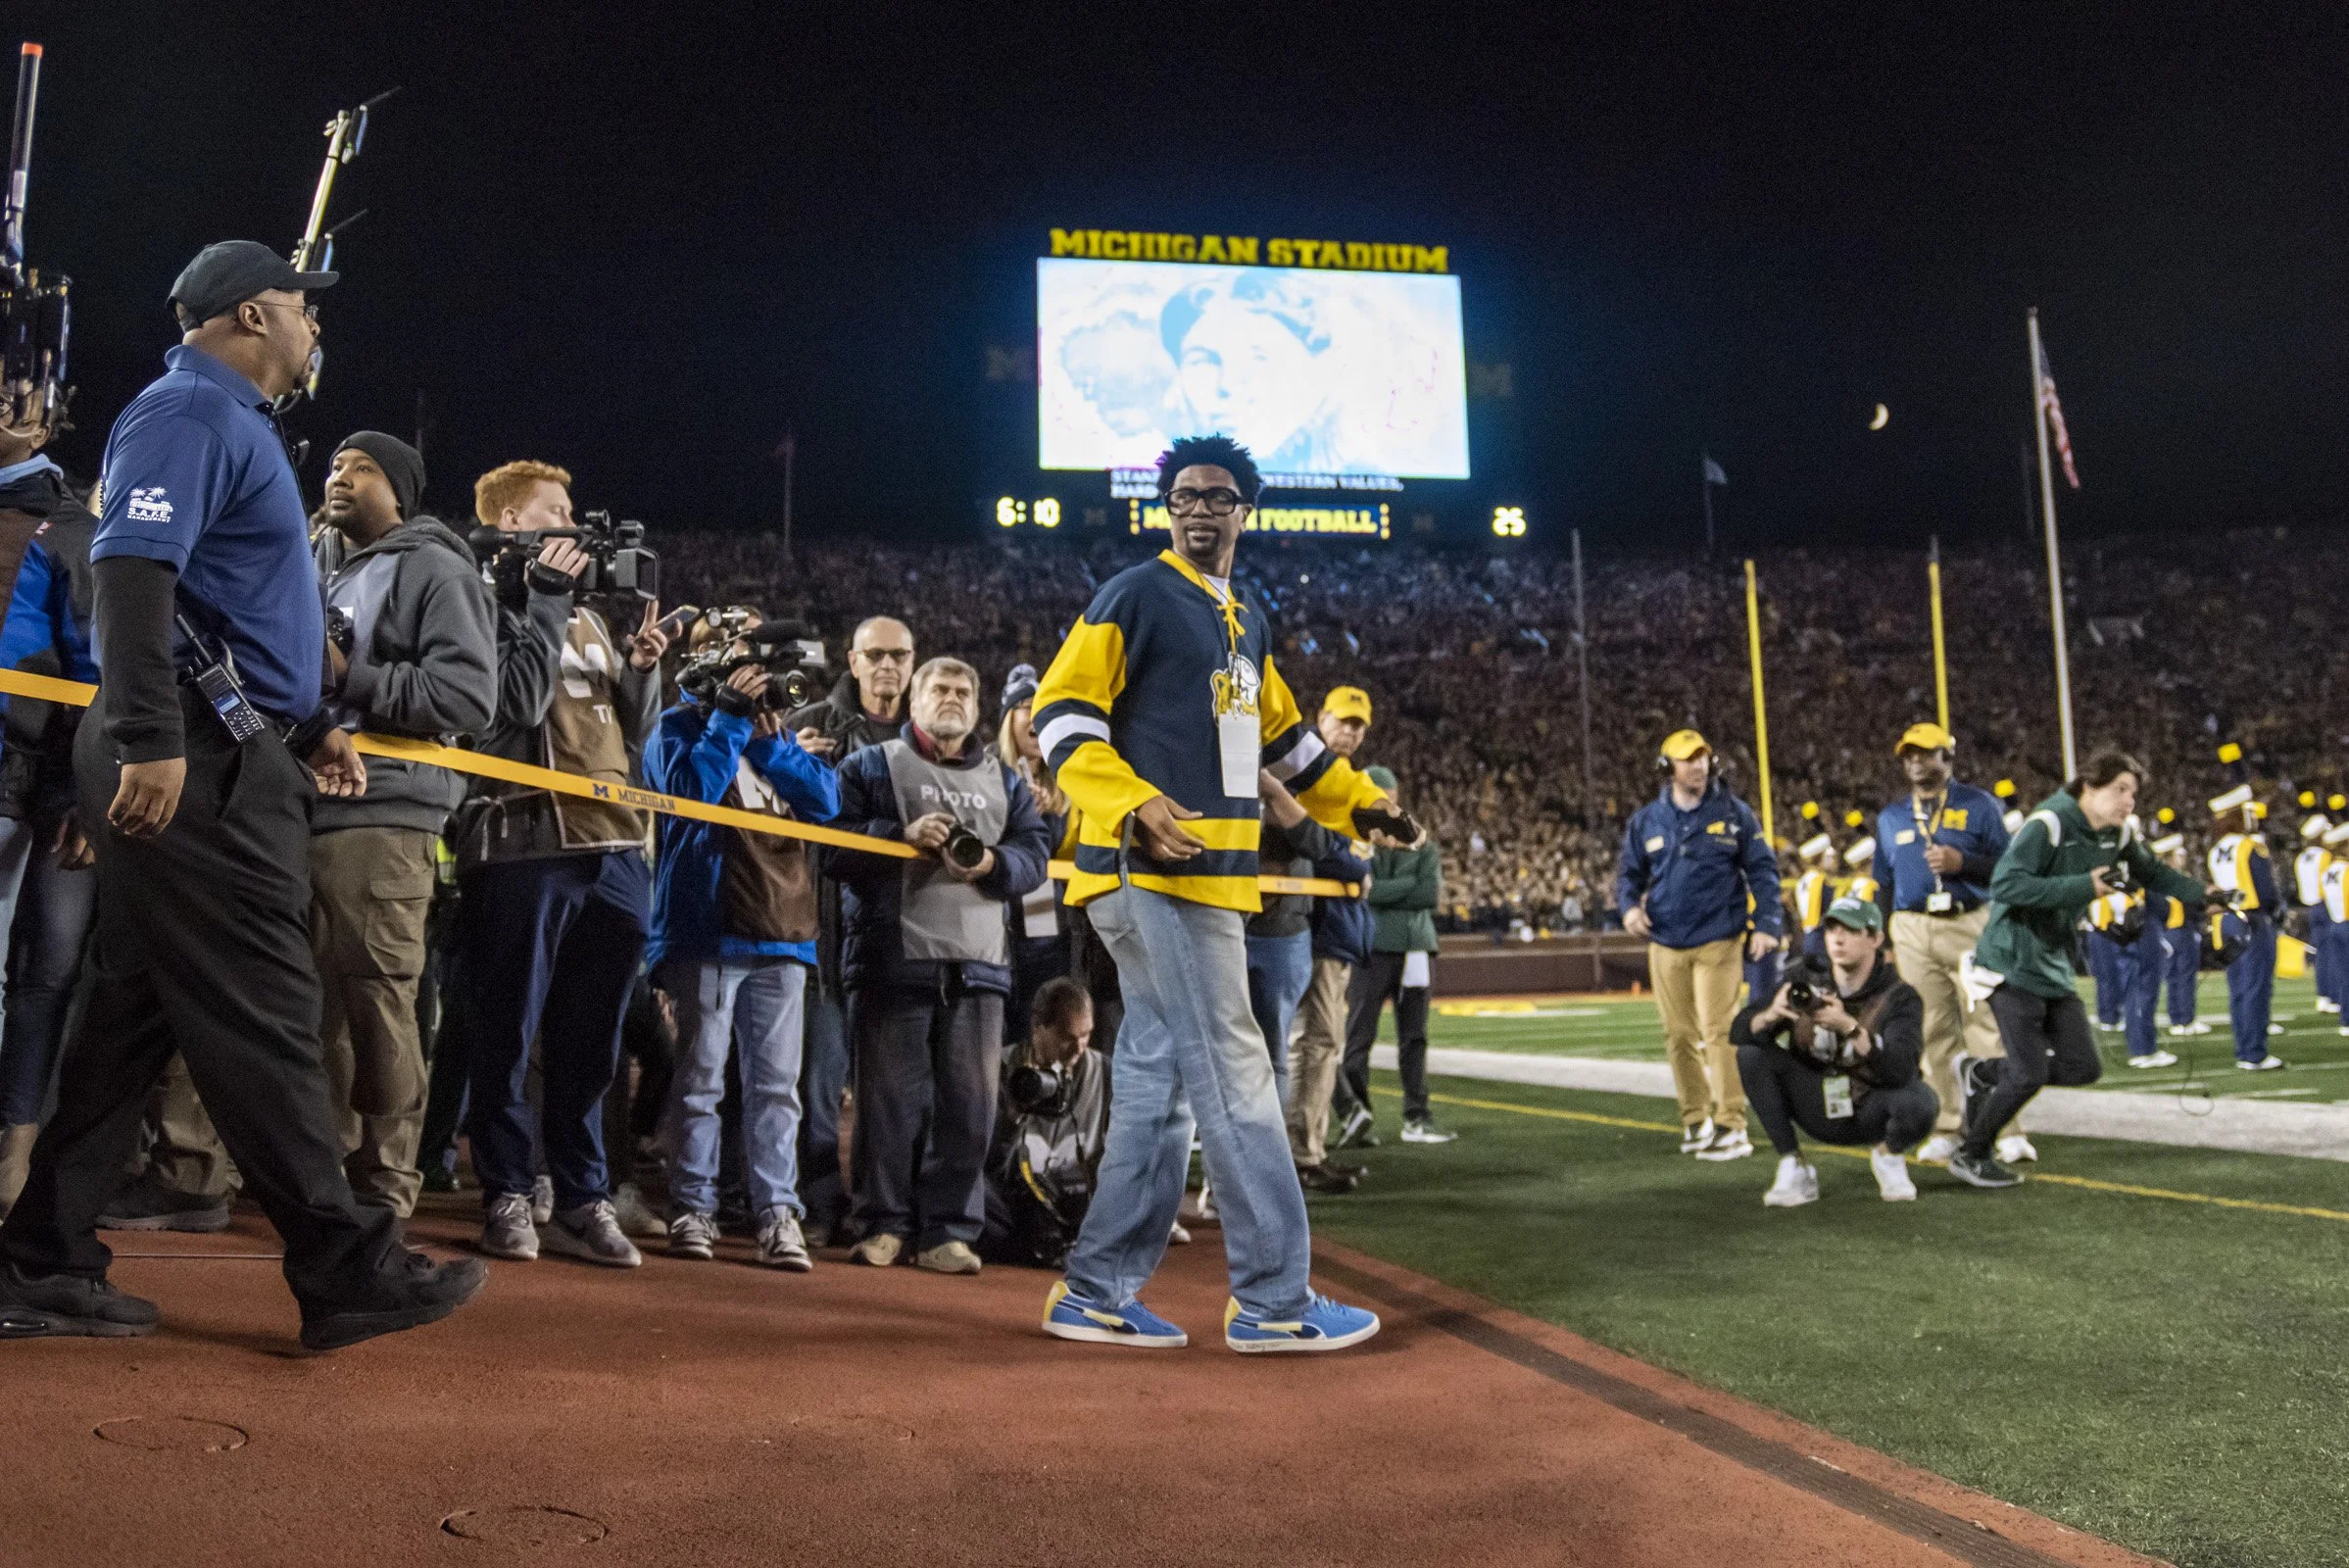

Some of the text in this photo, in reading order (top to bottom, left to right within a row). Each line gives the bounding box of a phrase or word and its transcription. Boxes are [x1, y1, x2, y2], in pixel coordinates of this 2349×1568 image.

[1050, 227, 1448, 272] MICHIGAN STADIUM
[1259, 508, 1378, 533] FOOTBALL
[1493, 507, 1527, 537] 25
[593, 783, 676, 812] M MICHIGAN
